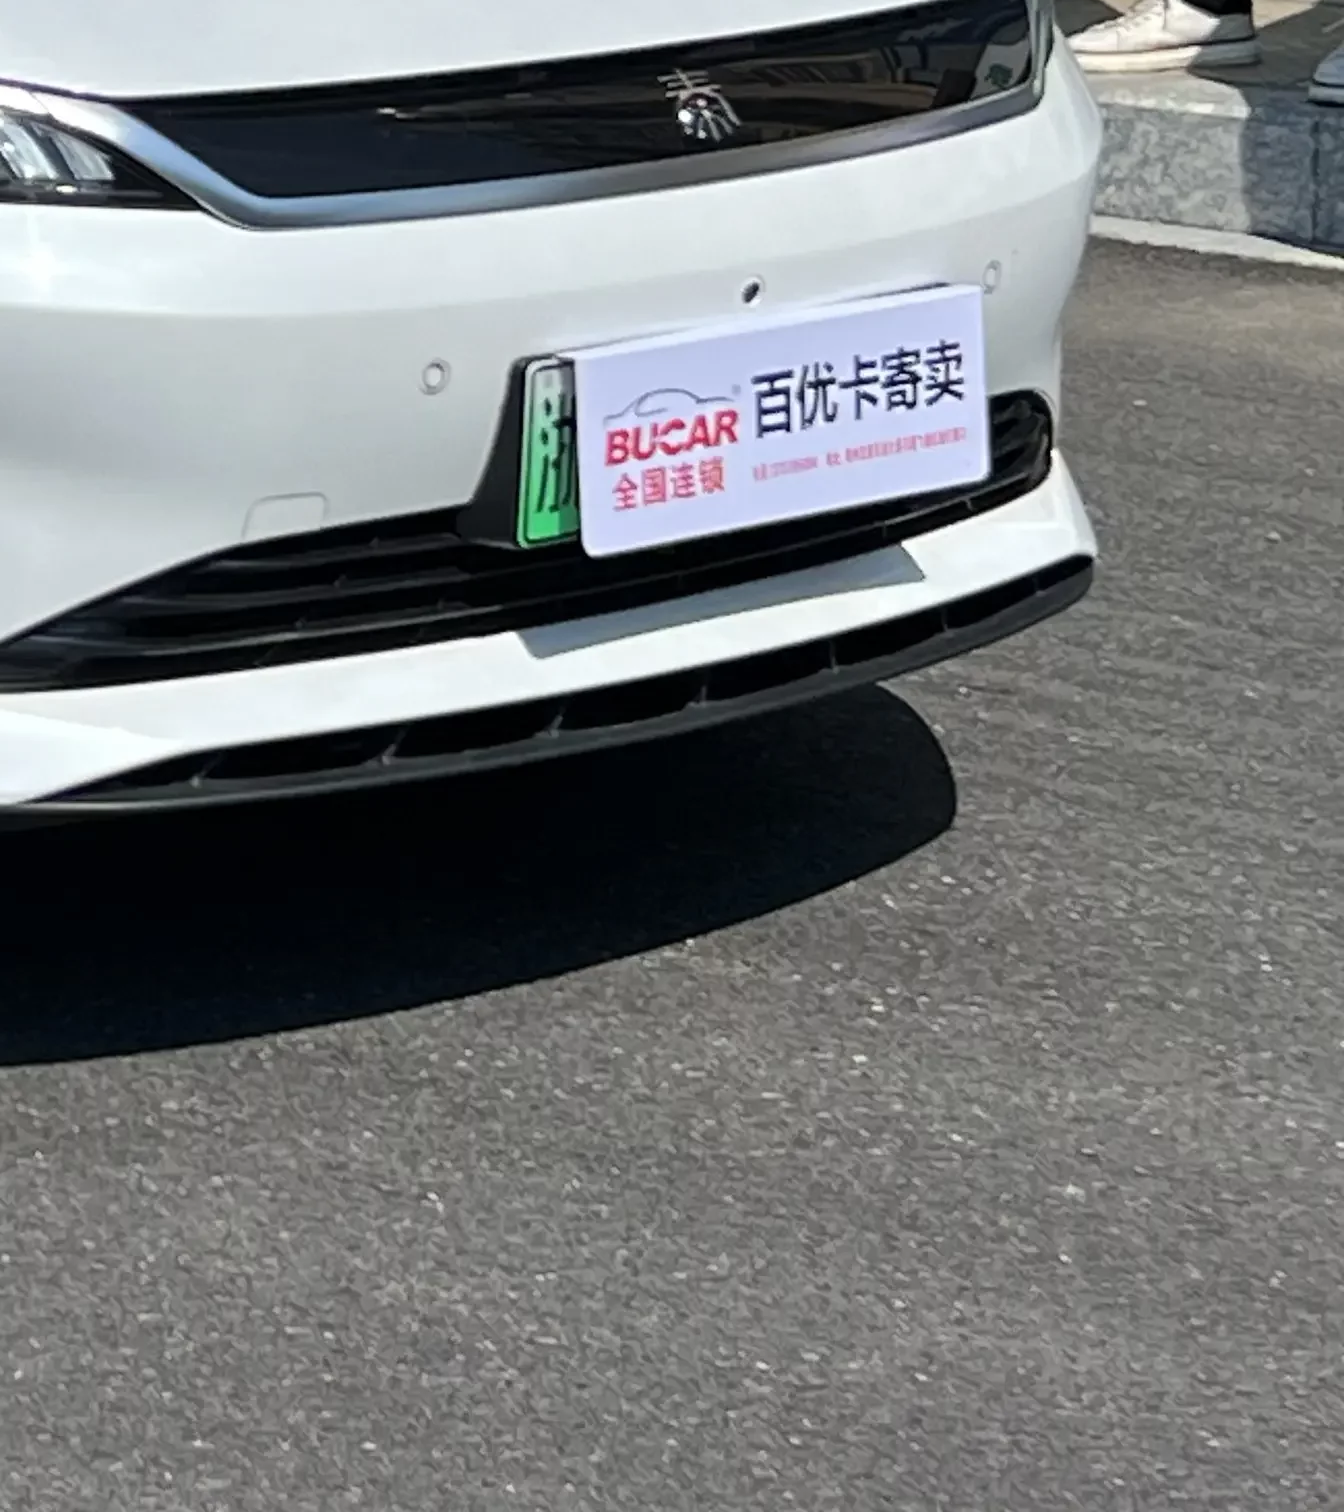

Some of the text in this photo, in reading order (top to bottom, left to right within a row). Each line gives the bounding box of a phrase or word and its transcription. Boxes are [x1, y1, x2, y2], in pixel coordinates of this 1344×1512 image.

[750, 338, 965, 439] 百优卡寄卖
[604, 408, 740, 467] BUCAR
[612, 455, 726, 512] 全国连锁
